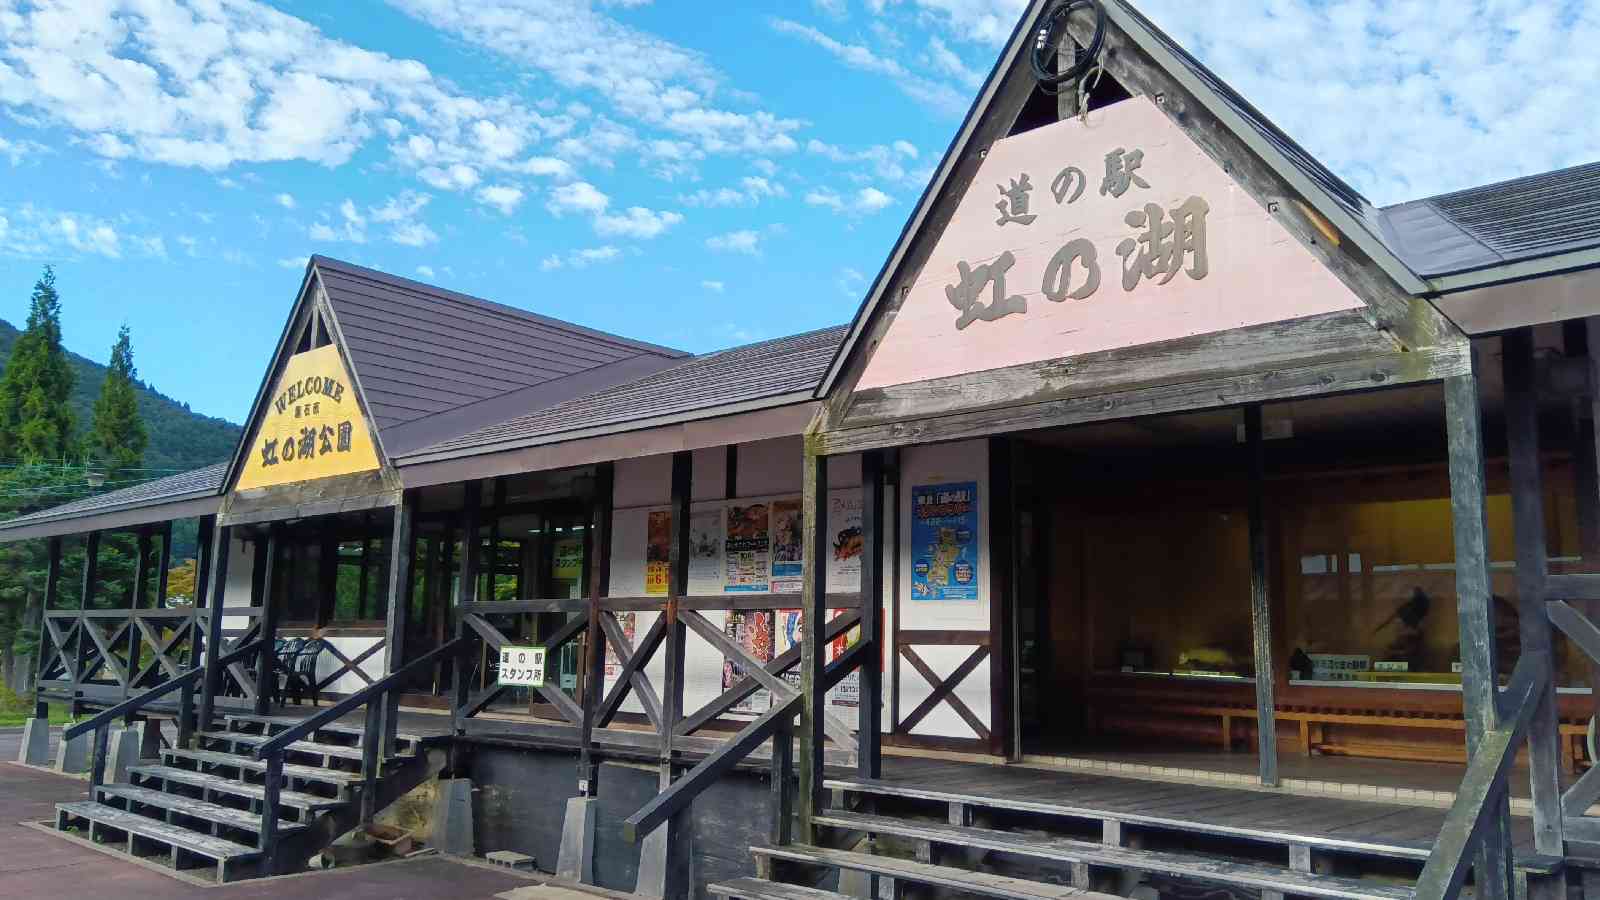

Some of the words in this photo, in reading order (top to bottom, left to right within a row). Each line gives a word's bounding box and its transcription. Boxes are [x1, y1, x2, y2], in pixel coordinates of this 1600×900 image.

[994, 148, 1151, 227] 道の駅
[945, 195, 1210, 331] 虹の湖
[275, 376, 345, 414] WELCOME
[262, 421, 353, 467] 虹の湖公園
[502, 652, 543, 664] 道の駅
[502, 668, 542, 681] スタンプ所
